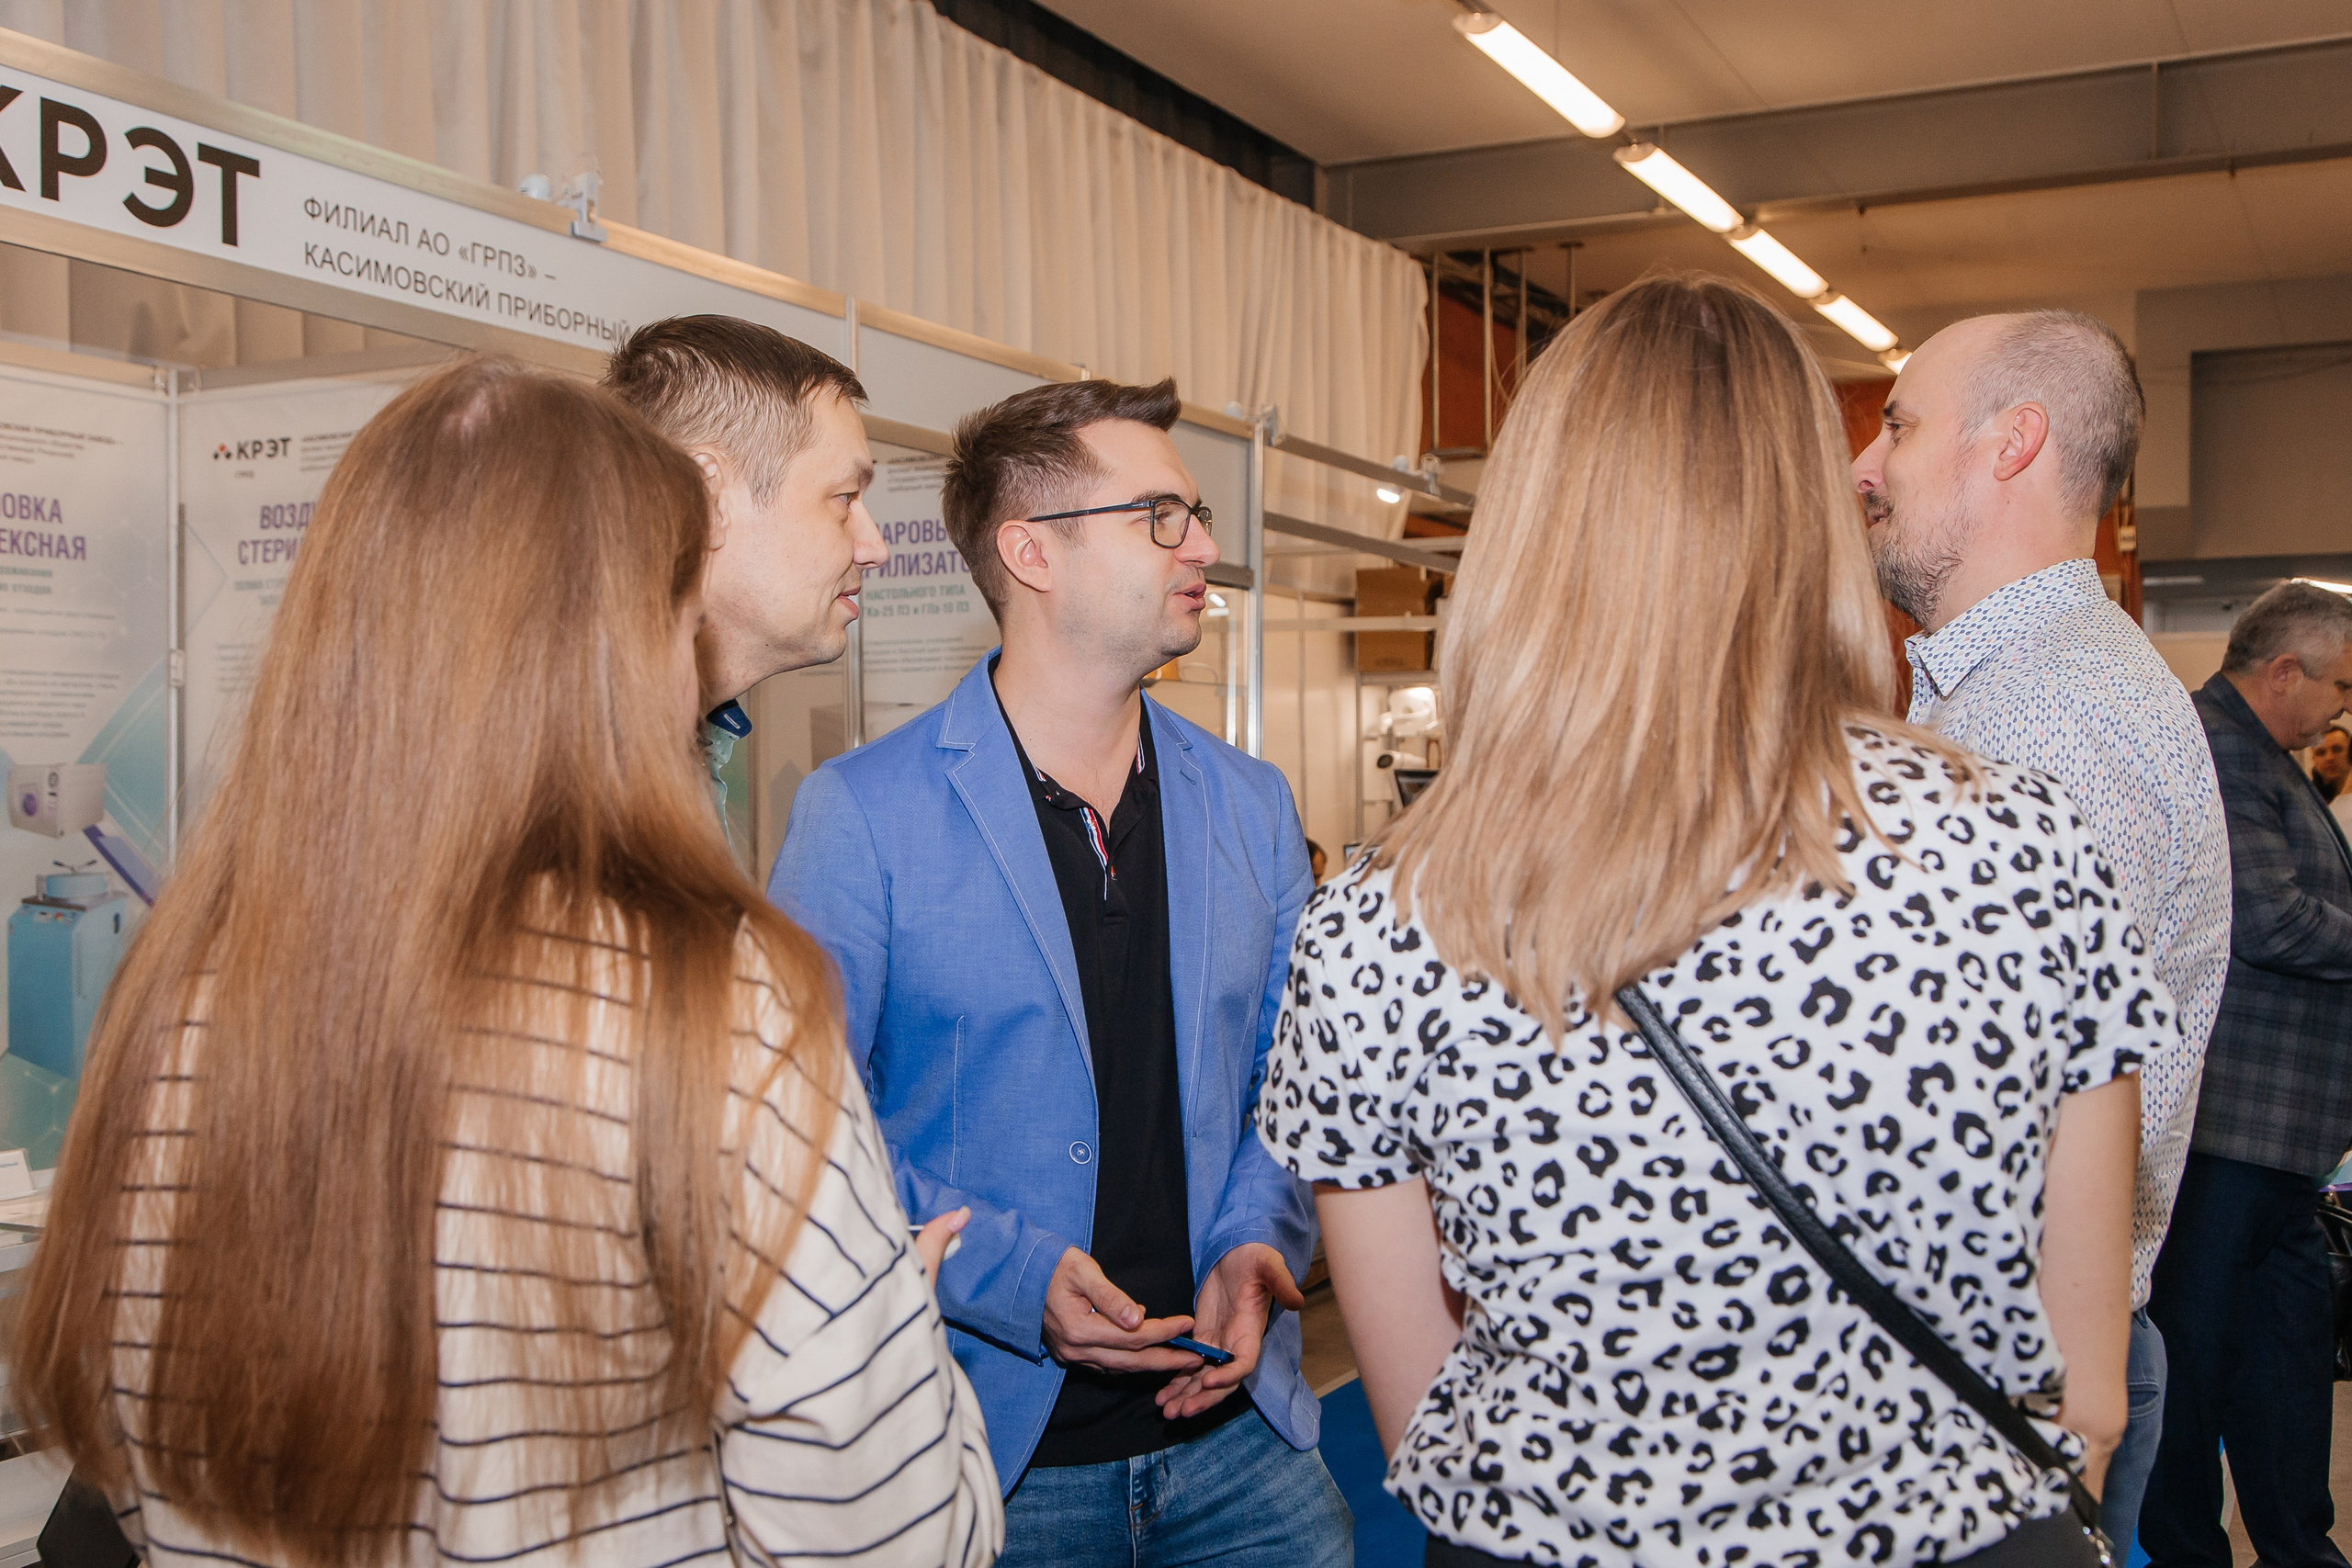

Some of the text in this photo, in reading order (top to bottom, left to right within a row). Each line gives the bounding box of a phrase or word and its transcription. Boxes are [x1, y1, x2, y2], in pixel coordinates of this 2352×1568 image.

[304, 196, 410, 246] ФИЛИАЛ
[417, 228, 450, 256] АО
[458, 242, 537, 280] «ГРПЗ»
[304, 241, 491, 310] КАСИМОВСКИЙ
[236, 437, 293, 460] КРЭТ
[0, 492, 63, 524] ОВКА
[259, 502, 316, 531] ВОЗД
[237, 537, 303, 565] СТЕРИ
